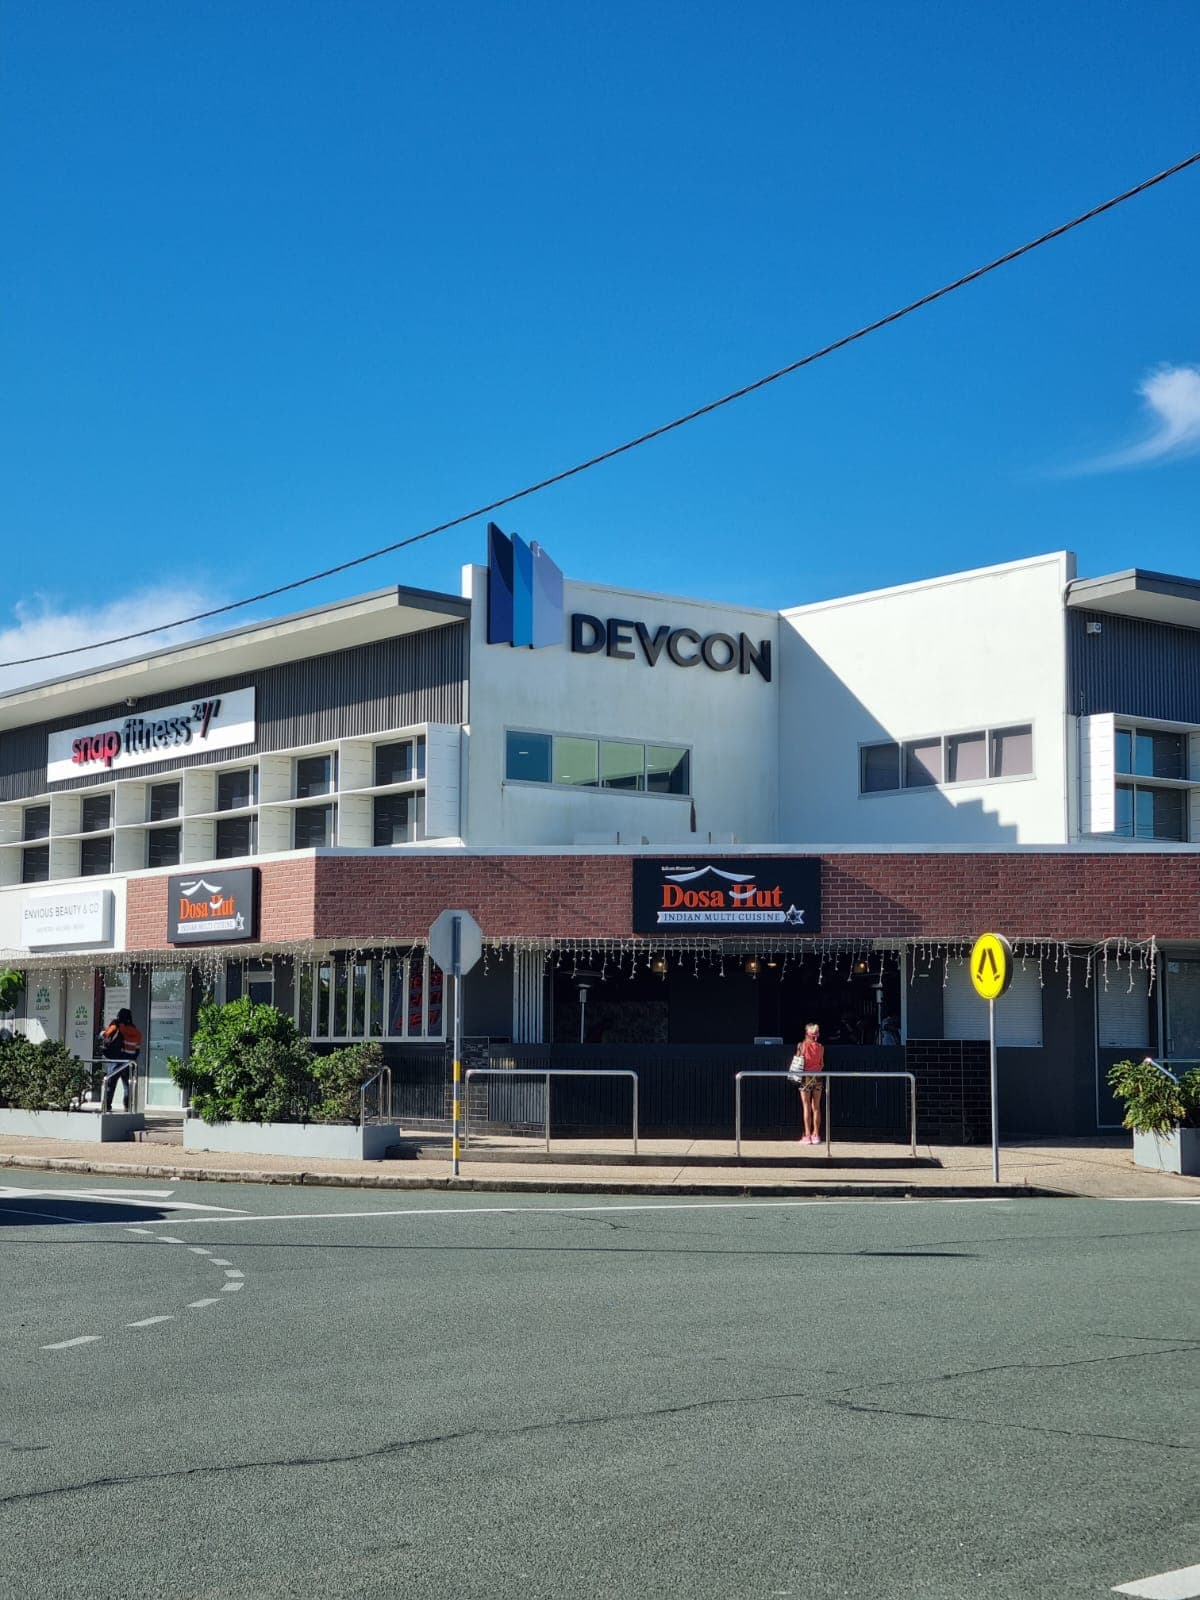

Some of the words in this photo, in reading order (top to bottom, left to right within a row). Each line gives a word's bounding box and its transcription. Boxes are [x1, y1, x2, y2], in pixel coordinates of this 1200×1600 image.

[571, 613, 771, 683] DEVCON
[72, 731, 119, 767] snap
[122, 716, 191, 753] fitness
[179, 898, 209, 921] Dosa
[210, 895, 235, 917] Hut
[661, 884, 725, 908] Dosa
[729, 884, 783, 908] Hut
[24, 907, 54, 920] ENVIOUS
[55, 905, 81, 917] BEAUTY
[664, 913, 702, 921] INDIAN
[704, 913, 735, 921] MULTI
[738, 913, 781, 921] CUISINE
